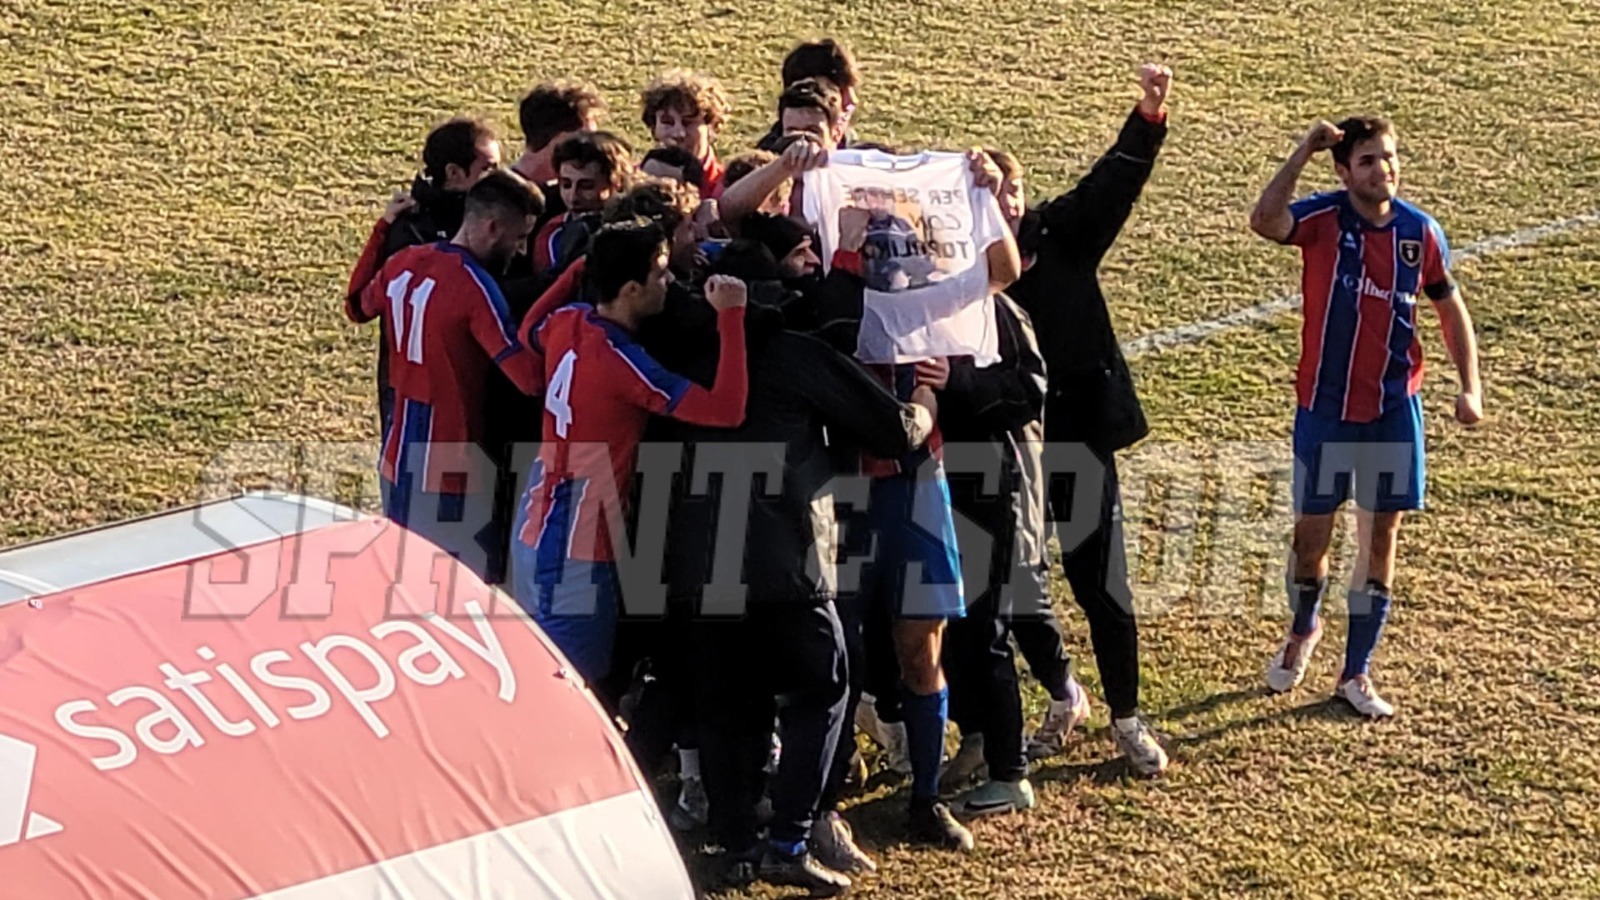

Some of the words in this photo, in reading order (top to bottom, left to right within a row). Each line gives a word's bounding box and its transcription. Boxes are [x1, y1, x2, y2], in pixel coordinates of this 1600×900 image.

[386, 269, 436, 365] 11
[545, 348, 578, 440] 4
[54, 600, 516, 771] satispay
